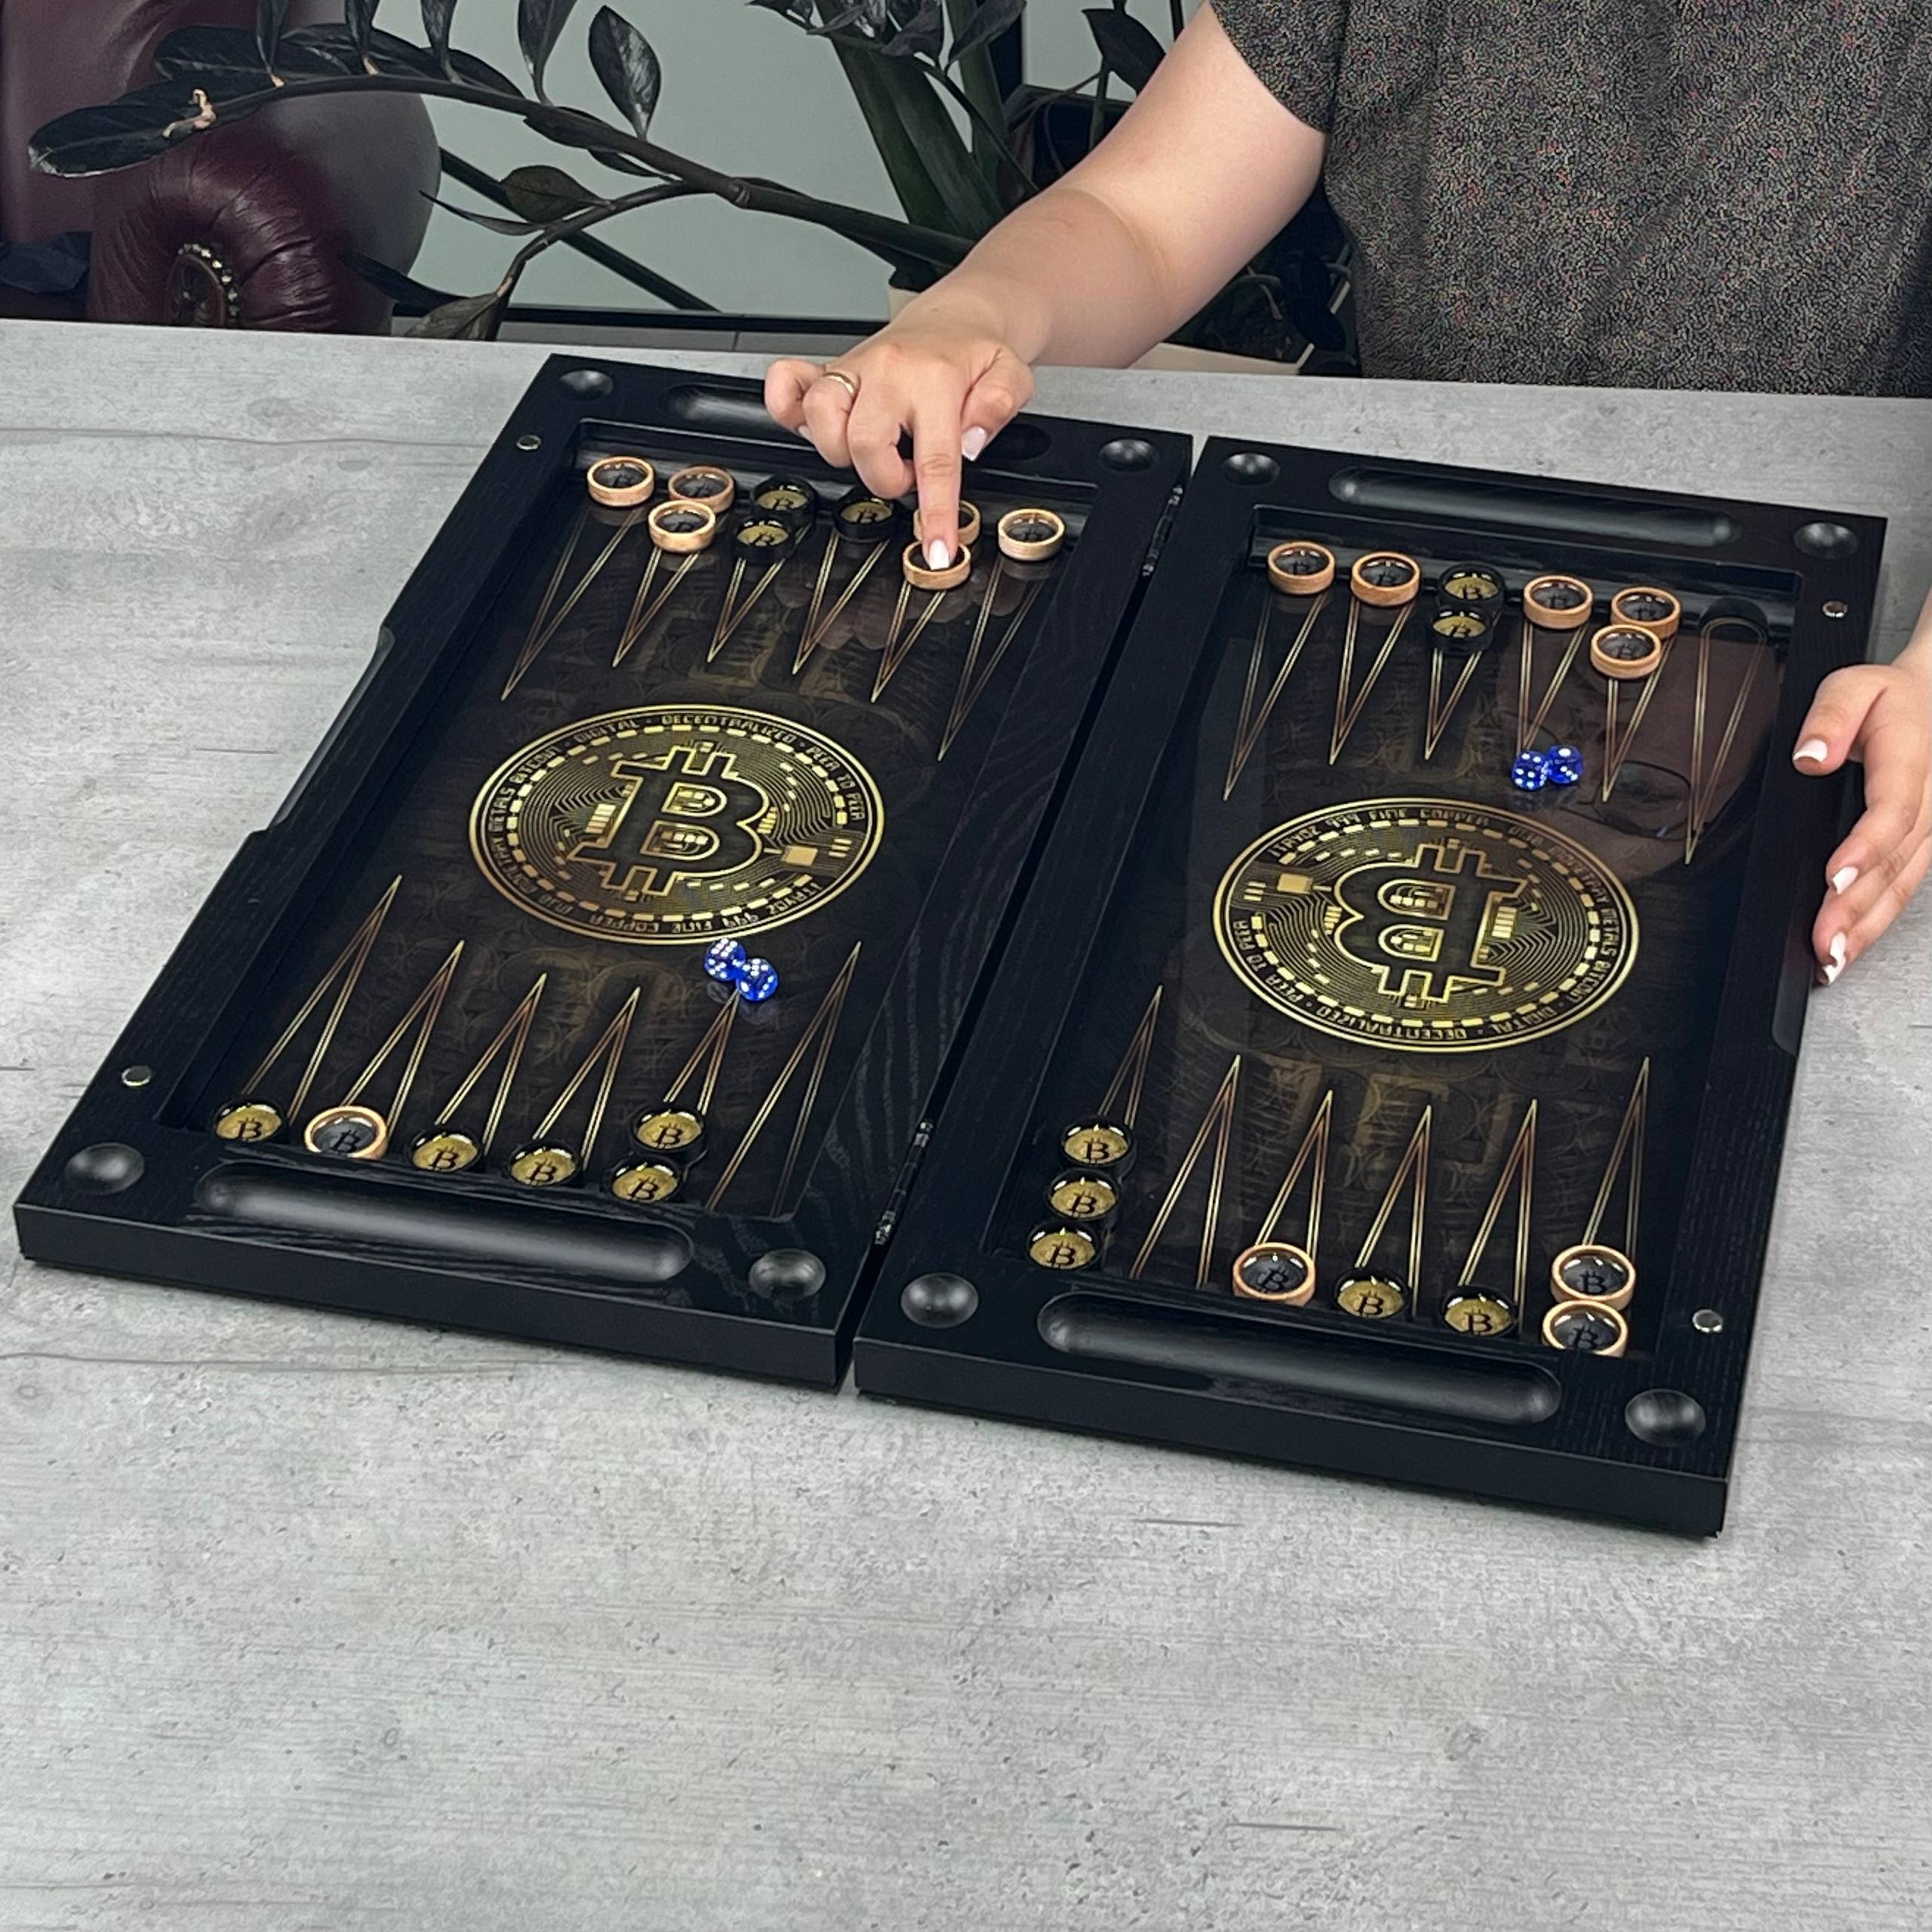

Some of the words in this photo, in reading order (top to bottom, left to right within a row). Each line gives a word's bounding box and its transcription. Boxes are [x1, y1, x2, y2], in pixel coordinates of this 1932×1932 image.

[573, 719, 640, 743] DIGITAL
[662, 715, 798, 743] DECENTRALIZED
[1368, 808, 1407, 820] FINE
[1420, 808, 1490, 826] COPPER
[589, 914, 660, 933] COPPER
[672, 920, 713, 934] FINE
[1246, 954, 1267, 972] TO
[1265, 974, 1304, 1003] PEER
[1315, 1006, 1467, 1040] DECENTRALIZED
[1487, 1007, 1557, 1034] DIGITAL
